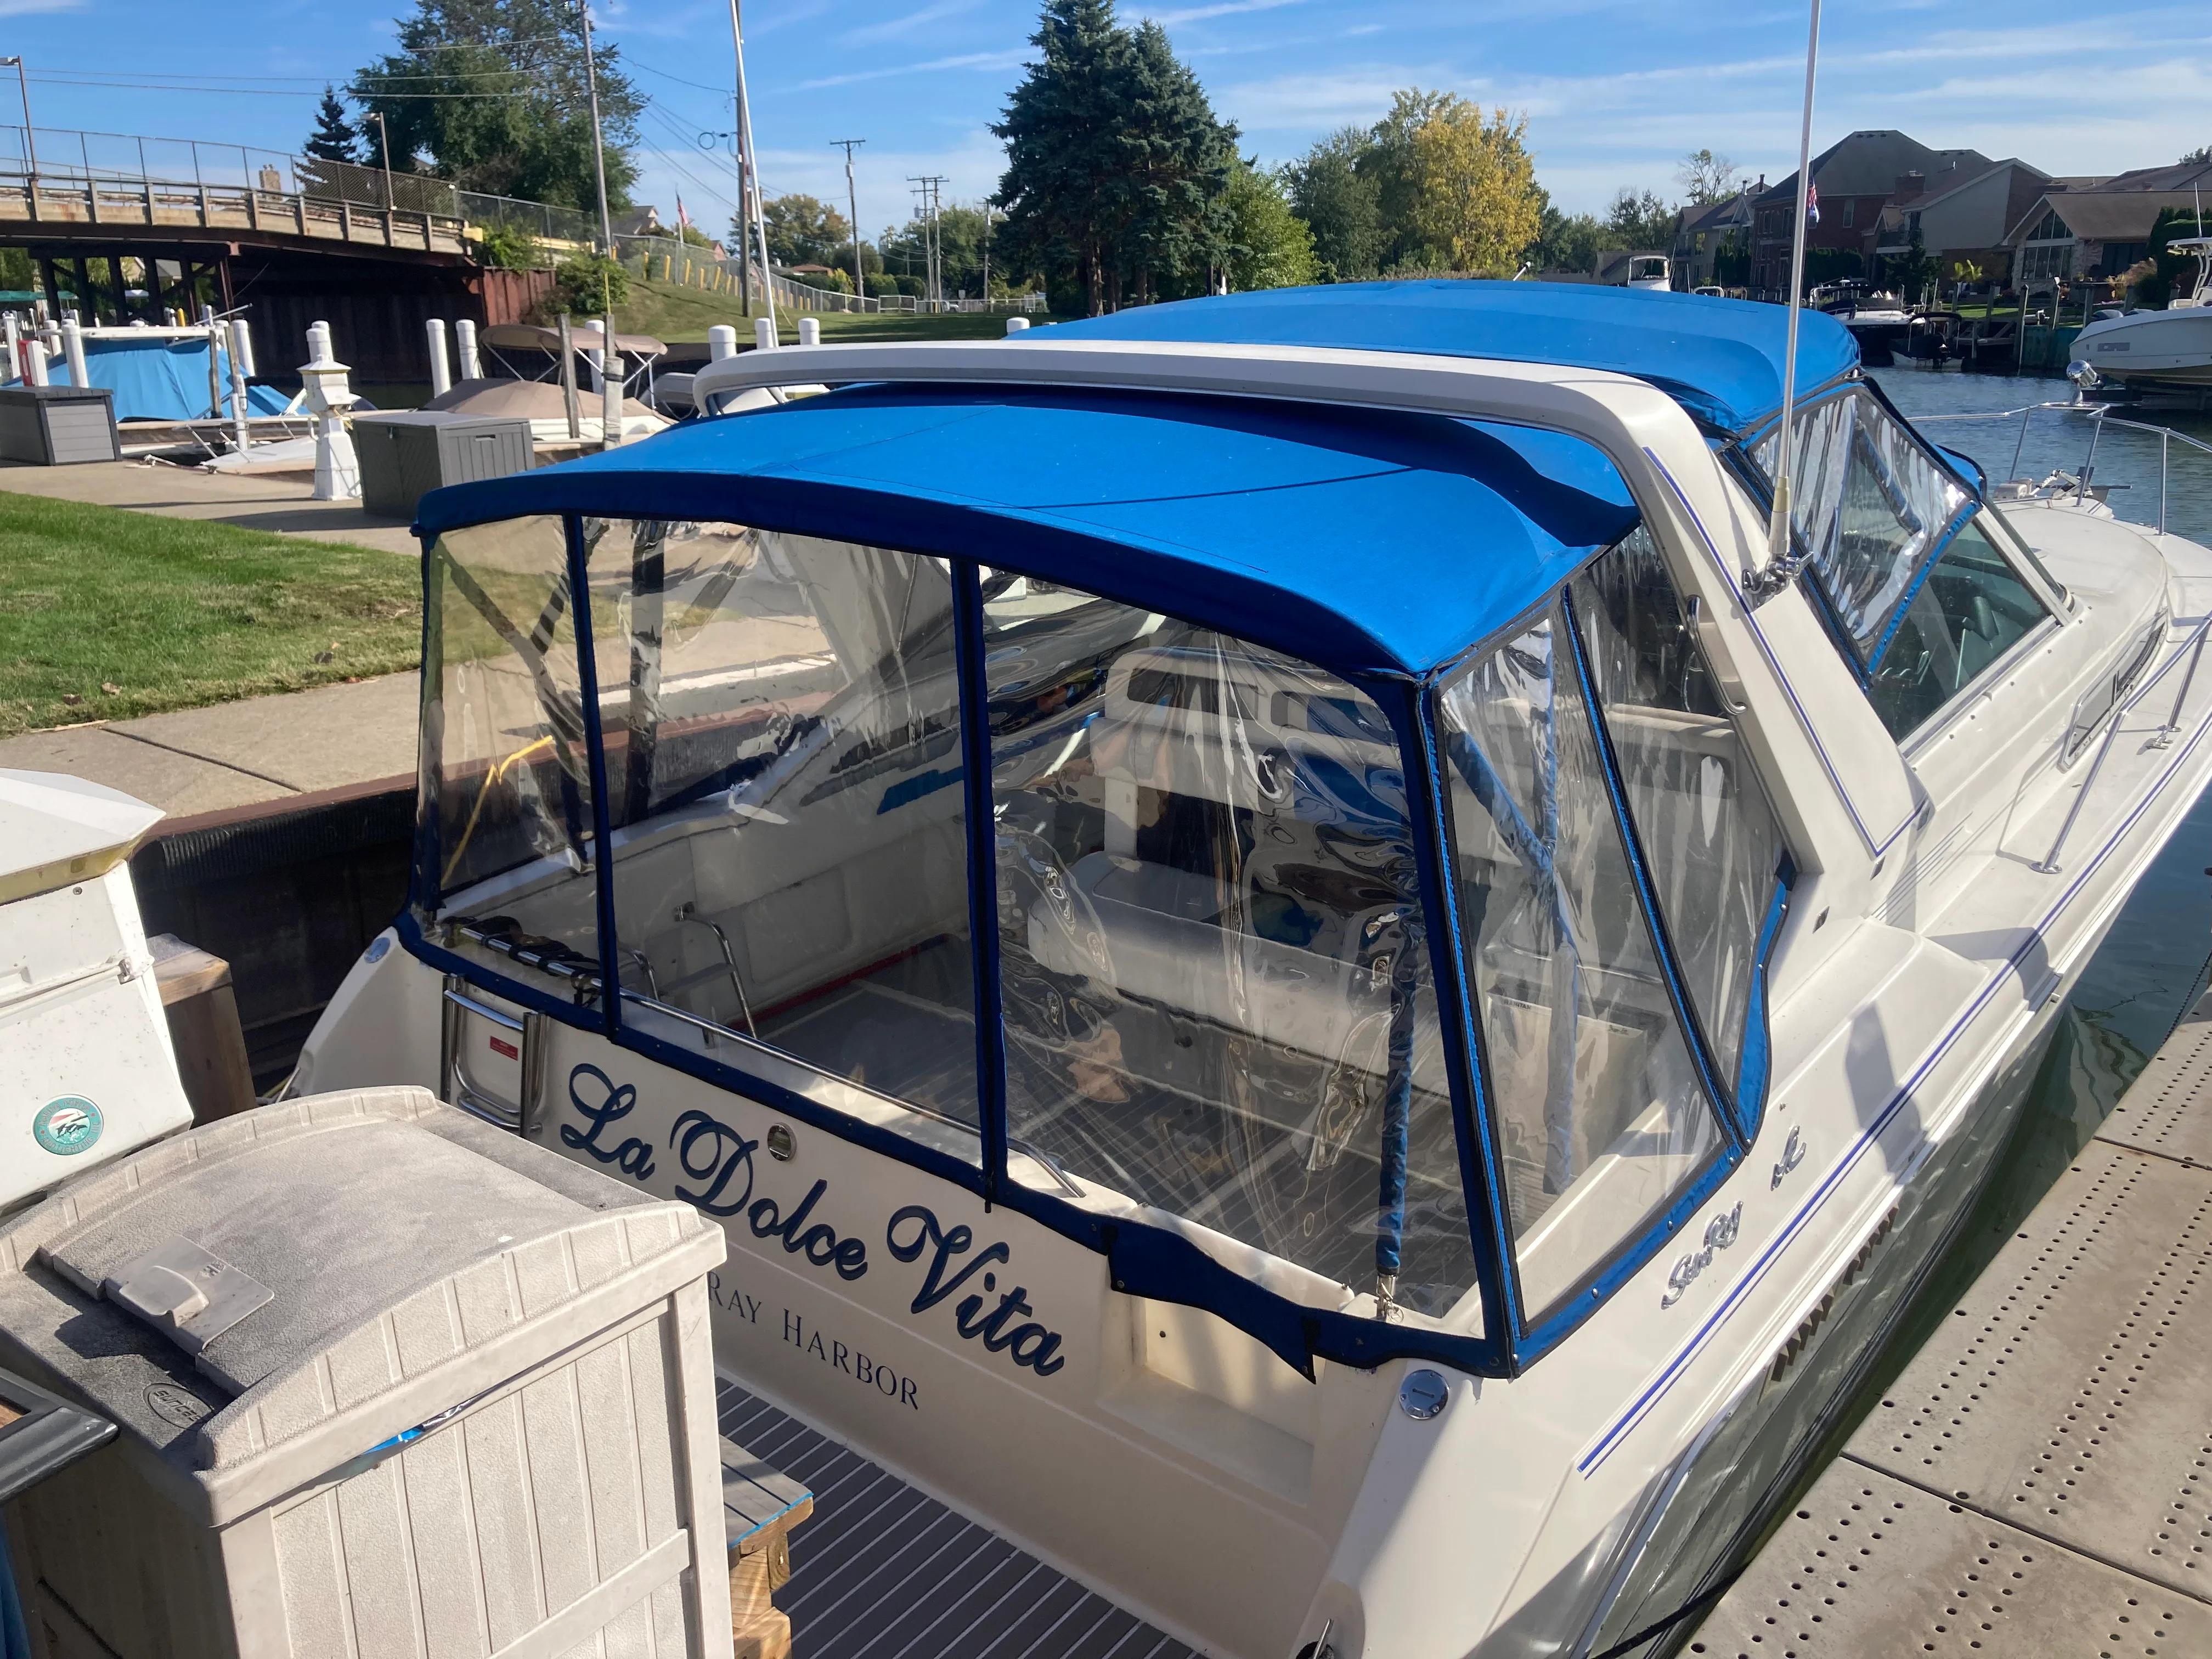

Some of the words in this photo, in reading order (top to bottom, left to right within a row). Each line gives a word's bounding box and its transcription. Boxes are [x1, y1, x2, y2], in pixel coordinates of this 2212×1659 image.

[561, 1063, 656, 1180] La
[669, 1109, 867, 1281] Dolce
[887, 1205, 1064, 1376] Vita
[153, 1390, 202, 1422] suncas
[783, 1307, 918, 1410] HARBOR
